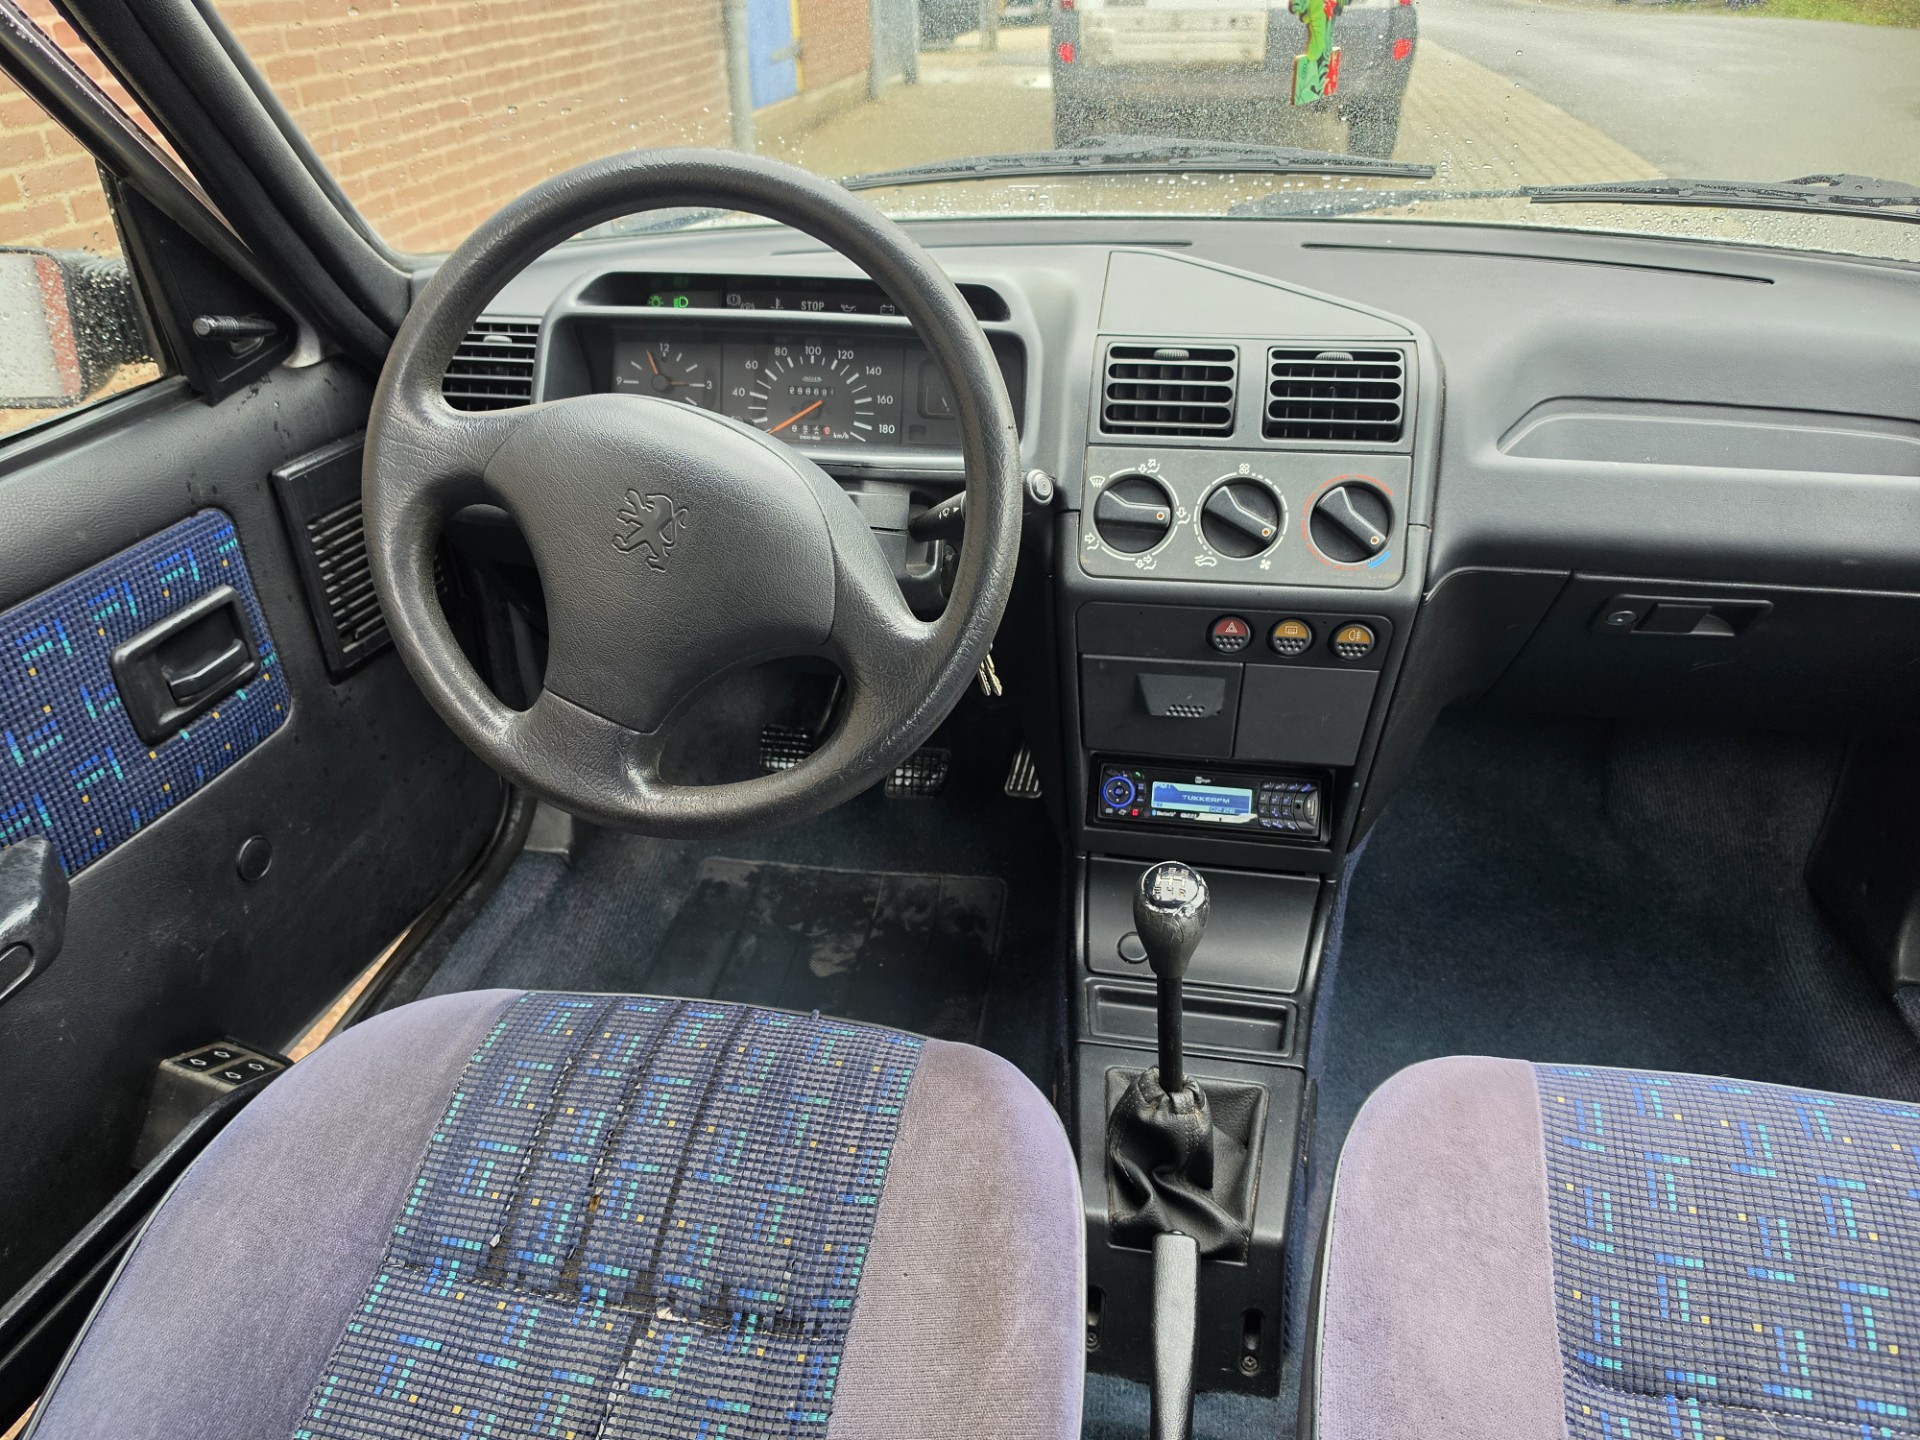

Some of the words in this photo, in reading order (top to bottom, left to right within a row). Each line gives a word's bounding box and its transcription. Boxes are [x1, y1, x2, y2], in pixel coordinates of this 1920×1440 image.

[801, 301, 825, 311] STOP
[659, 343, 670, 353] 12
[774, 347, 788, 356] 80
[805, 346, 822, 356] 100
[838, 350, 854, 360] 120
[745, 360, 759, 370] 60
[866, 366, 882, 376] 140
[616, 376, 623, 386] 9
[706, 380, 712, 390] 3
[732, 387, 746, 397] 40
[877, 395, 893, 405] 160
[878, 424, 895, 434] 180
[833, 431, 850, 440] km/h
